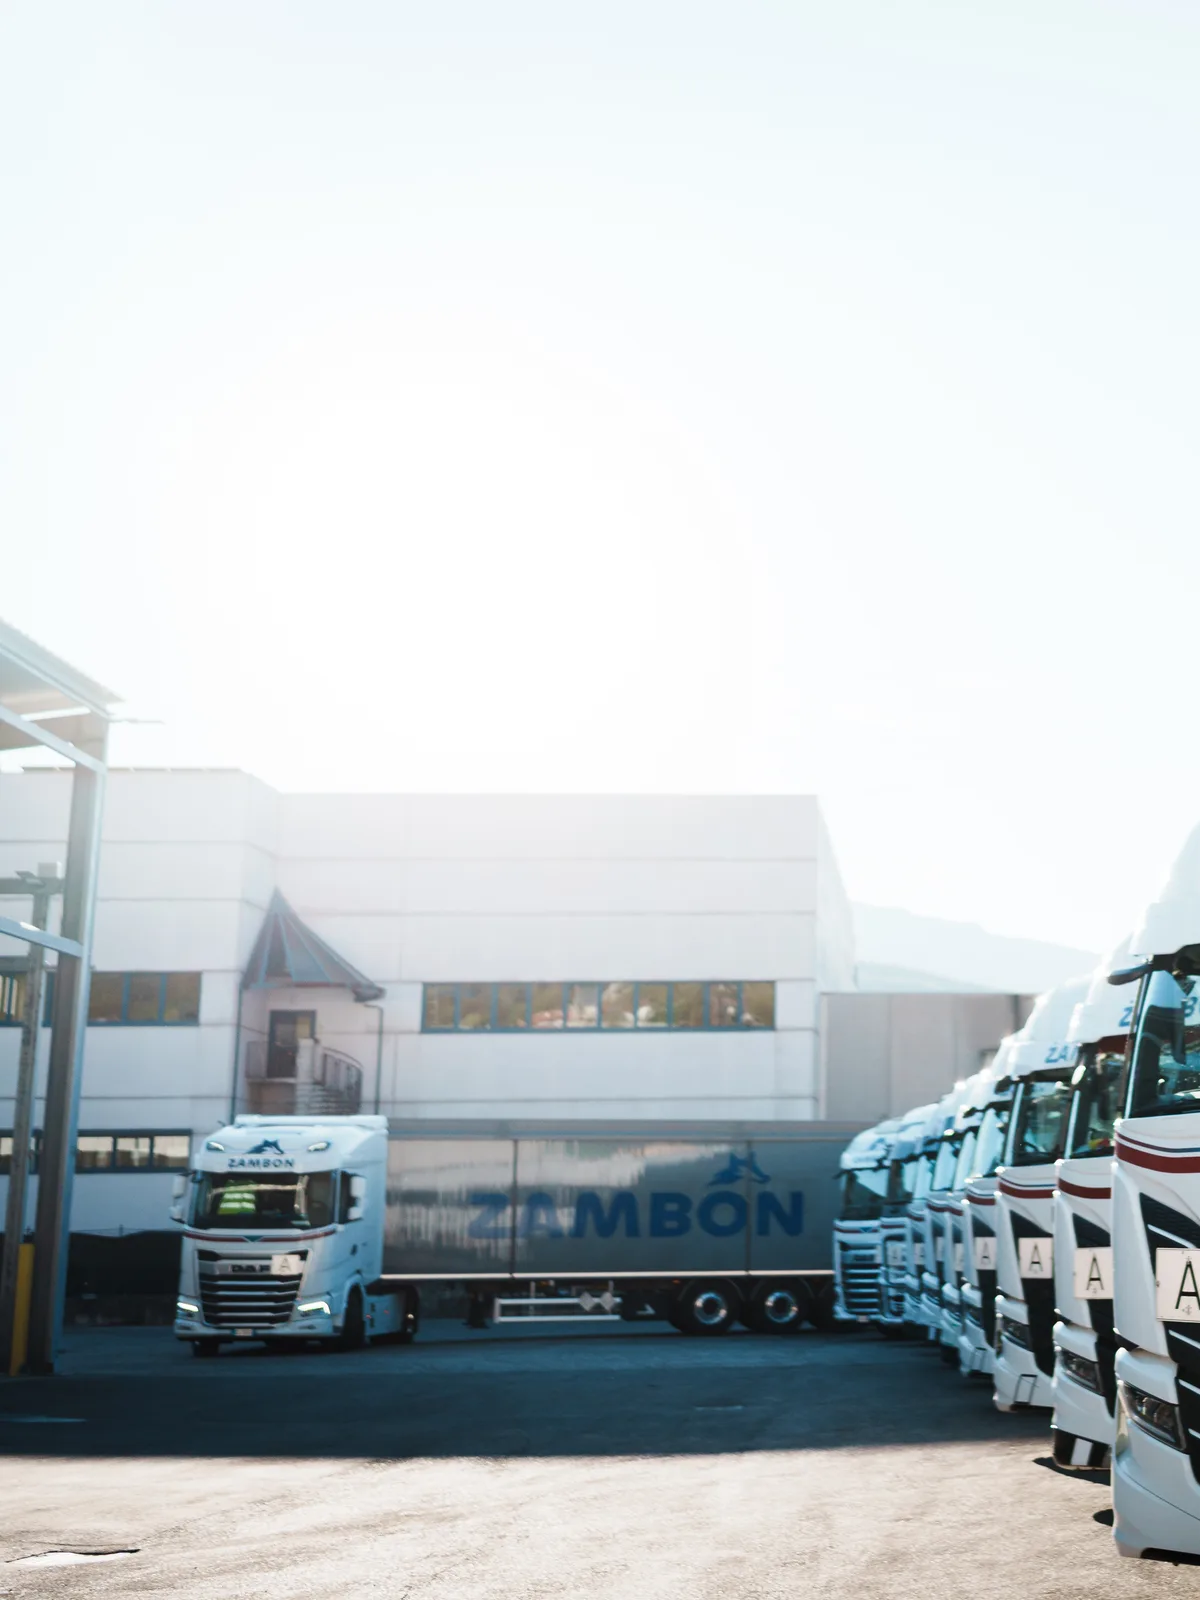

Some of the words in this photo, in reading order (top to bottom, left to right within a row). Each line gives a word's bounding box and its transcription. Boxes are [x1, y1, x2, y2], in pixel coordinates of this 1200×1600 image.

[227, 1158, 295, 1168] ZAMBON
[467, 1189, 805, 1239] ZAMBON
[278, 1256, 292, 1272] A
[1028, 1243, 1044, 1272] A
[1085, 1252, 1105, 1291] A
